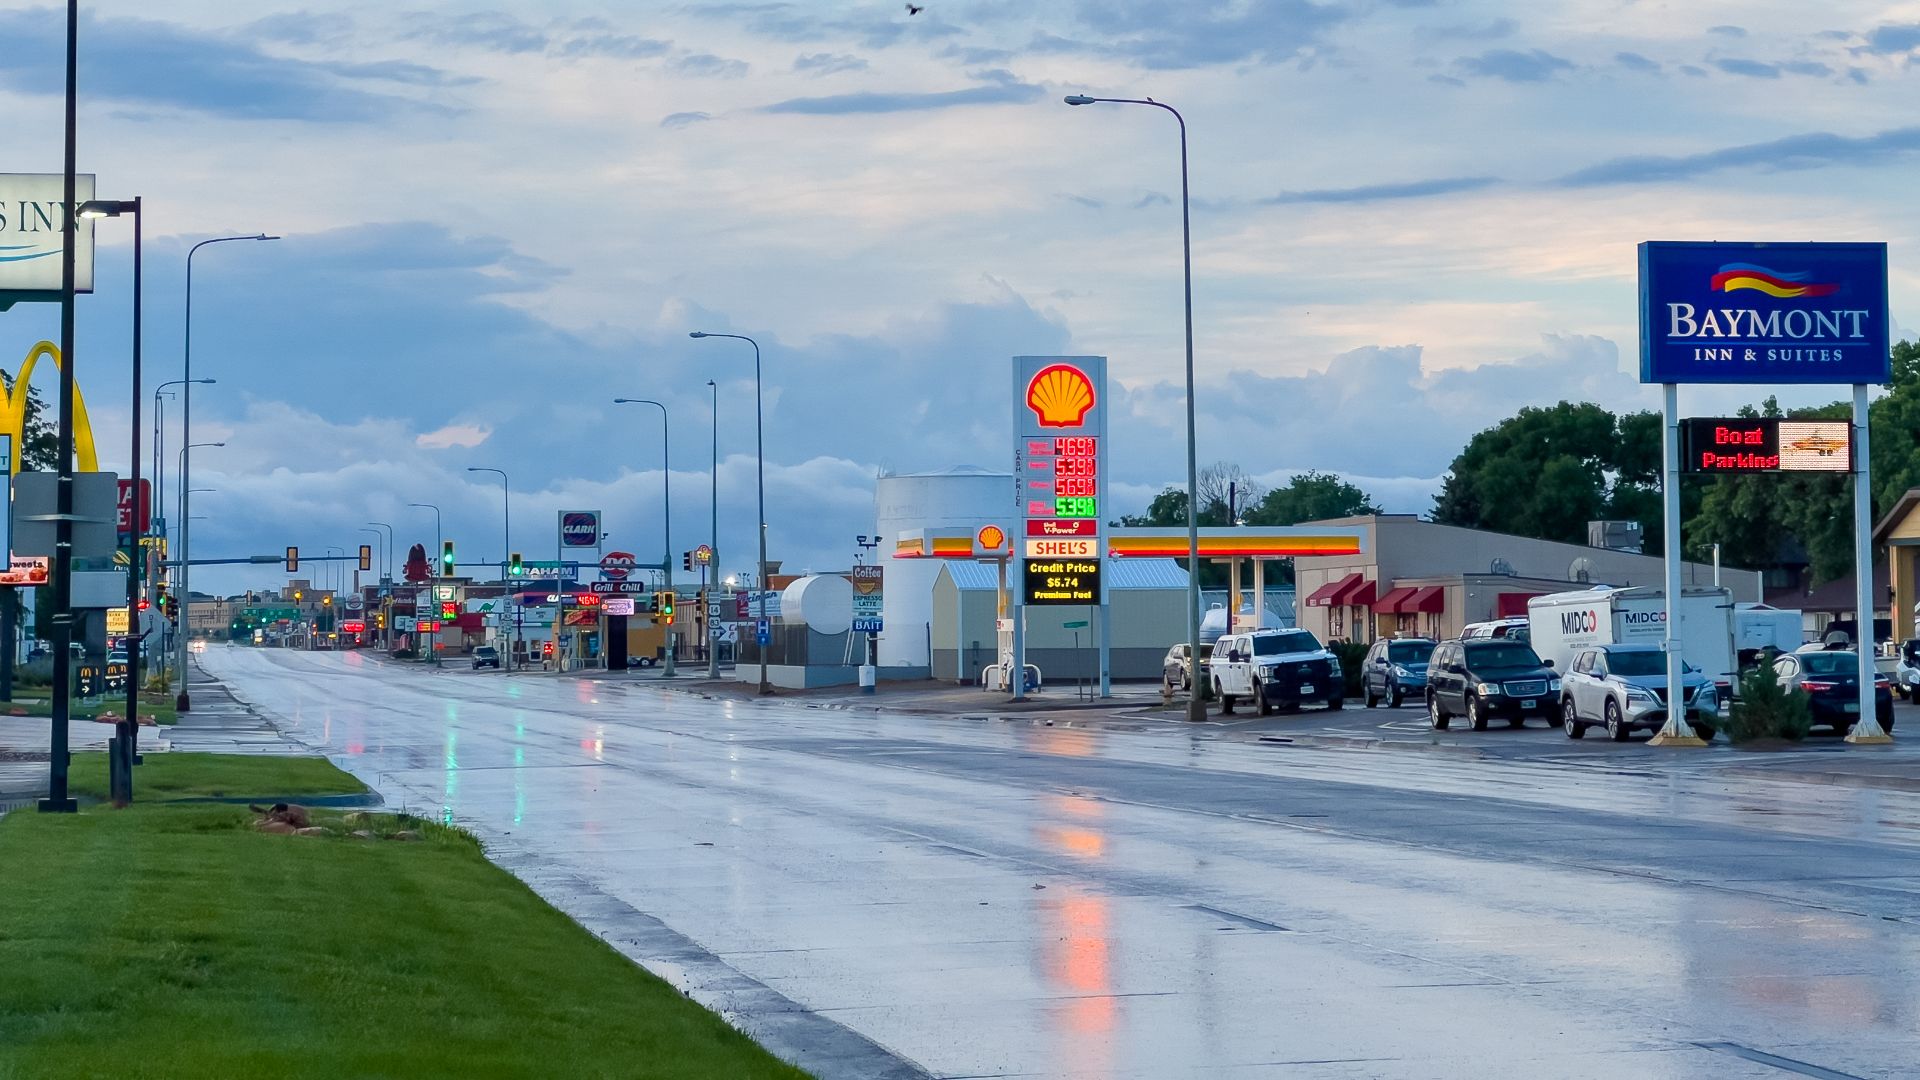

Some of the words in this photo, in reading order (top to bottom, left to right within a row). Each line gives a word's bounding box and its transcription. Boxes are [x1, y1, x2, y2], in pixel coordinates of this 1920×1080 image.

[1667, 303, 1869, 338] BAYMONT
[1694, 348, 1733, 360] INN
[1744, 348, 1756, 361] &
[1767, 348, 1843, 361] SUITES
[1715, 427, 1763, 444] Boat
[1703, 452, 1779, 468] Parking
[563, 524, 595, 534] CLARK
[1035, 541, 1088, 555] SHEL'S
[508, 567, 573, 575] RAHAM
[855, 566, 881, 577] Coffee
[1030, 563, 1064, 573] Credit
[1066, 563, 1096, 573] Price
[593, 583, 614, 592] Grill
[619, 583, 641, 592] Chill
[1034, 591, 1072, 599] Premium
[1073, 591, 1092, 599] Fuel
[710, 606, 719, 614] 14
[710, 619, 720, 627] 83
[1561, 610, 1597, 634] MIDCO
[1625, 612, 1667, 623] MIDCO
[757, 620, 769, 634] H
[855, 620, 882, 630] BAIT
